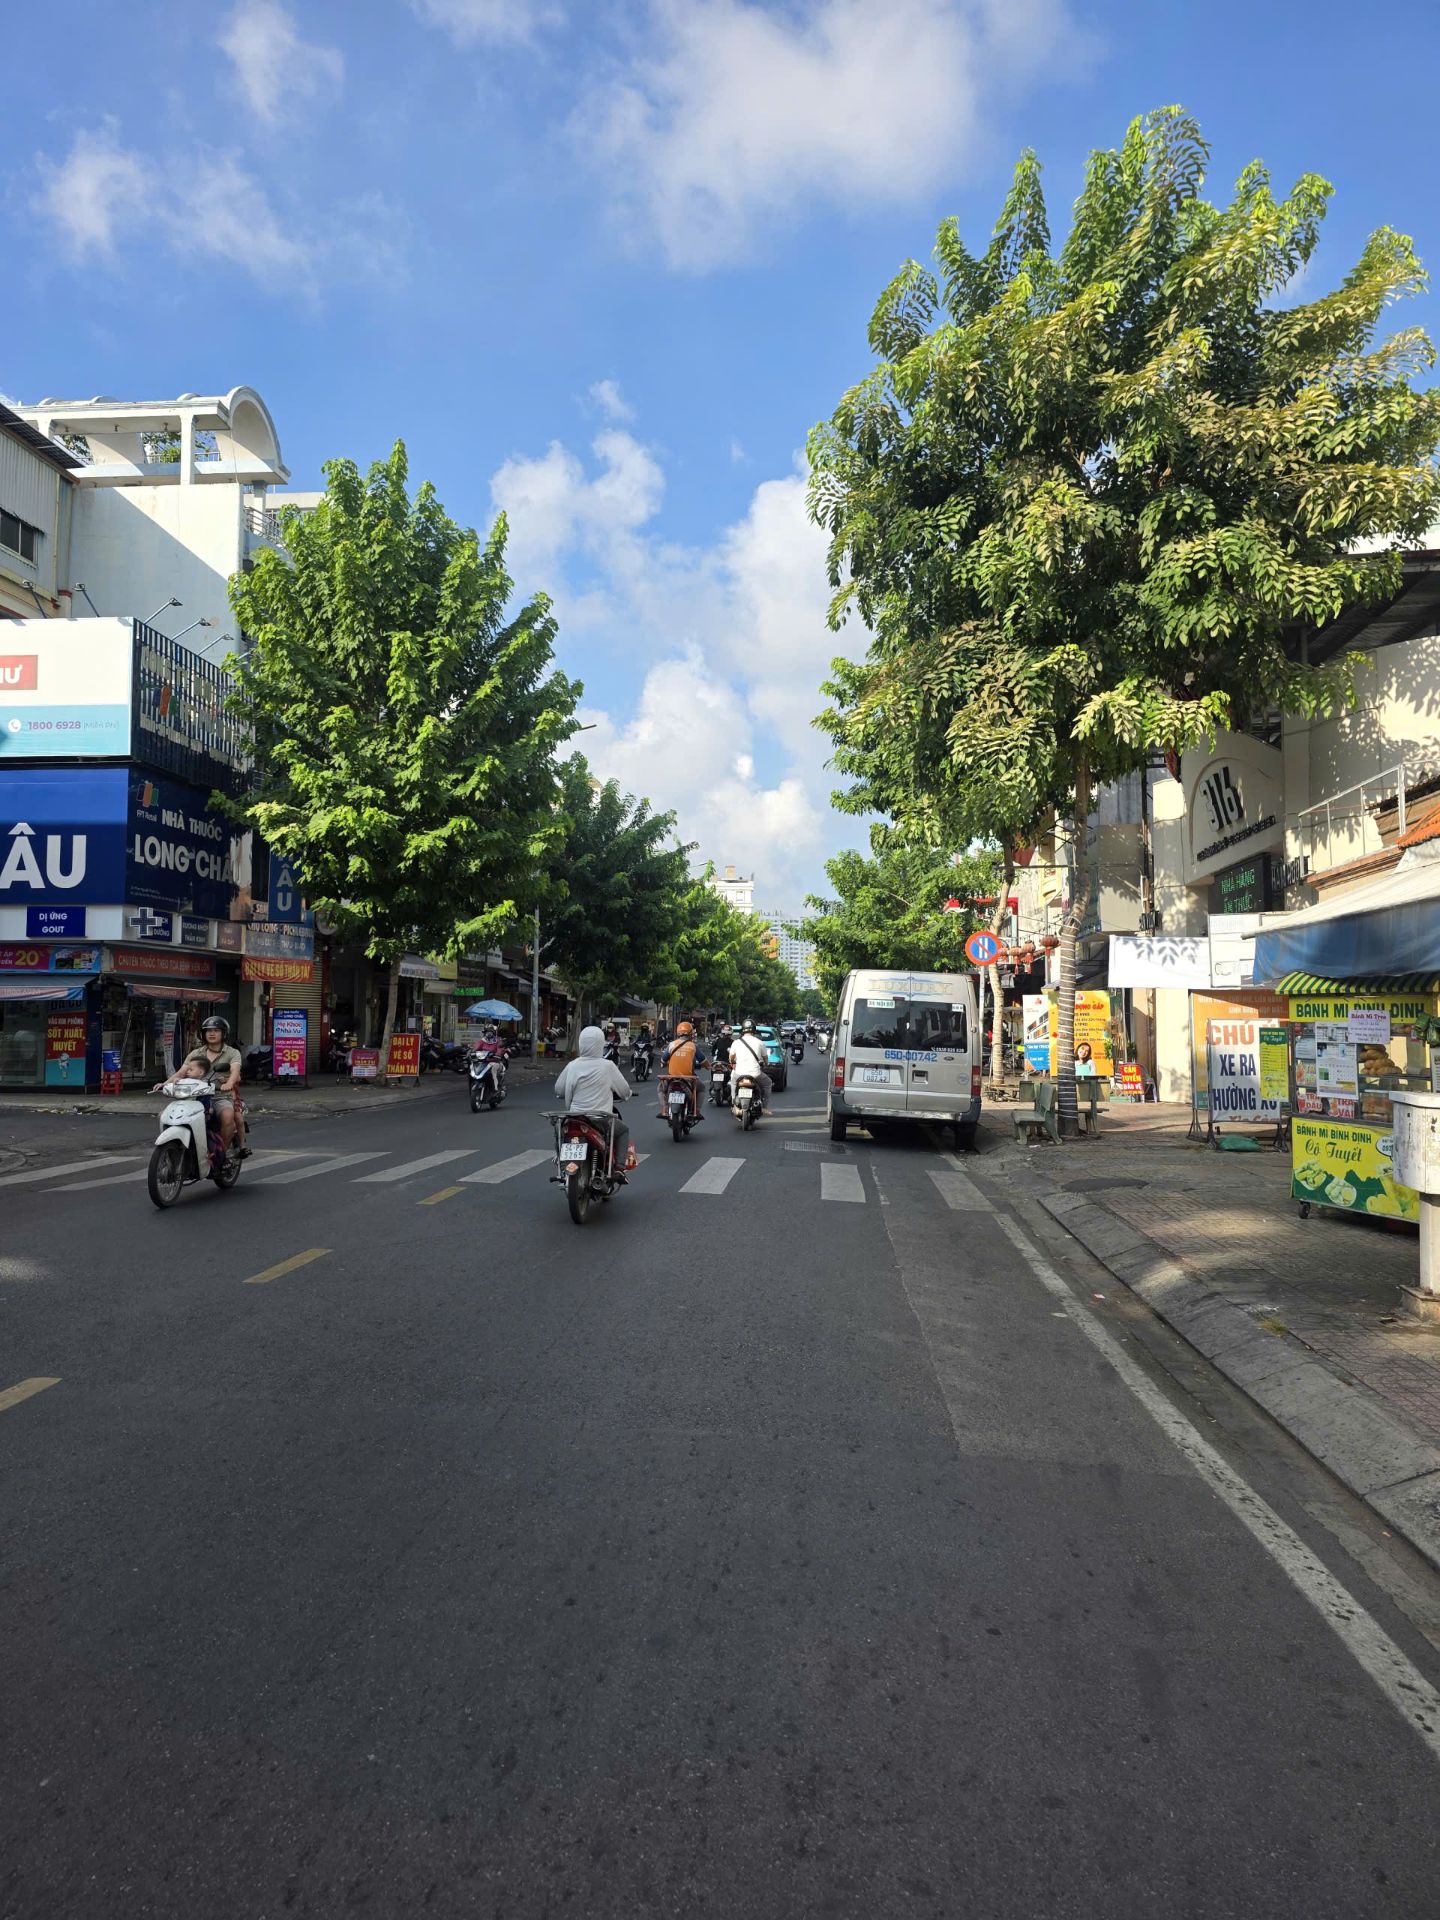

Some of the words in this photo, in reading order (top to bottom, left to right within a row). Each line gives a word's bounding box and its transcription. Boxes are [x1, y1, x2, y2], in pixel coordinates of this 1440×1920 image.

[28, 721, 52, 730] 1800
[56, 721, 81, 730] 6928
[1199, 767, 1241, 832] 316
[161, 808, 185, 830] NHÀ
[188, 818, 223, 842] THUỐC
[134, 833, 190, 873] LONG
[39, 913, 47, 922] DỊ
[49, 911, 67, 920] ỨNG
[871, 982, 951, 992] LUXURY
[1296, 998, 1328, 1018] BÁNH
[1333, 997, 1348, 1018] MÌ
[1390, 1002, 1425, 1022] ĐỊNH
[47, 1025, 62, 1039] SỐT
[64, 1025, 83, 1039] XUẤT
[1206, 1020, 1255, 1046] CHÚ
[53, 1039, 77, 1051] HUYẾT
[392, 1037, 405, 1047] ĐẠI
[406, 1036, 414, 1046] LÝ
[393, 1050, 402, 1060] VÉ
[403, 1049, 413, 1060] SỐ
[884, 1050, 938, 1063] 65D-007.42
[387, 1062, 405, 1074] THẦN
[406, 1063, 418, 1074] TÀI
[1219, 1054, 1236, 1076] XE
[1239, 1054, 1257, 1076] RA
[1122, 1074, 1142, 1082] TUYỂN
[1212, 1083, 1257, 1111] HƯỜNG
[1296, 1123, 1316, 1137] BÁNH
[1319, 1127, 1329, 1138] MÌ
[1331, 1127, 1349, 1141] BÌNH
[1351, 1132, 1372, 1146] ĐỊNH
[1305, 1139, 1320, 1156] Cô
[1326, 1141, 1362, 1163] Tuyết
